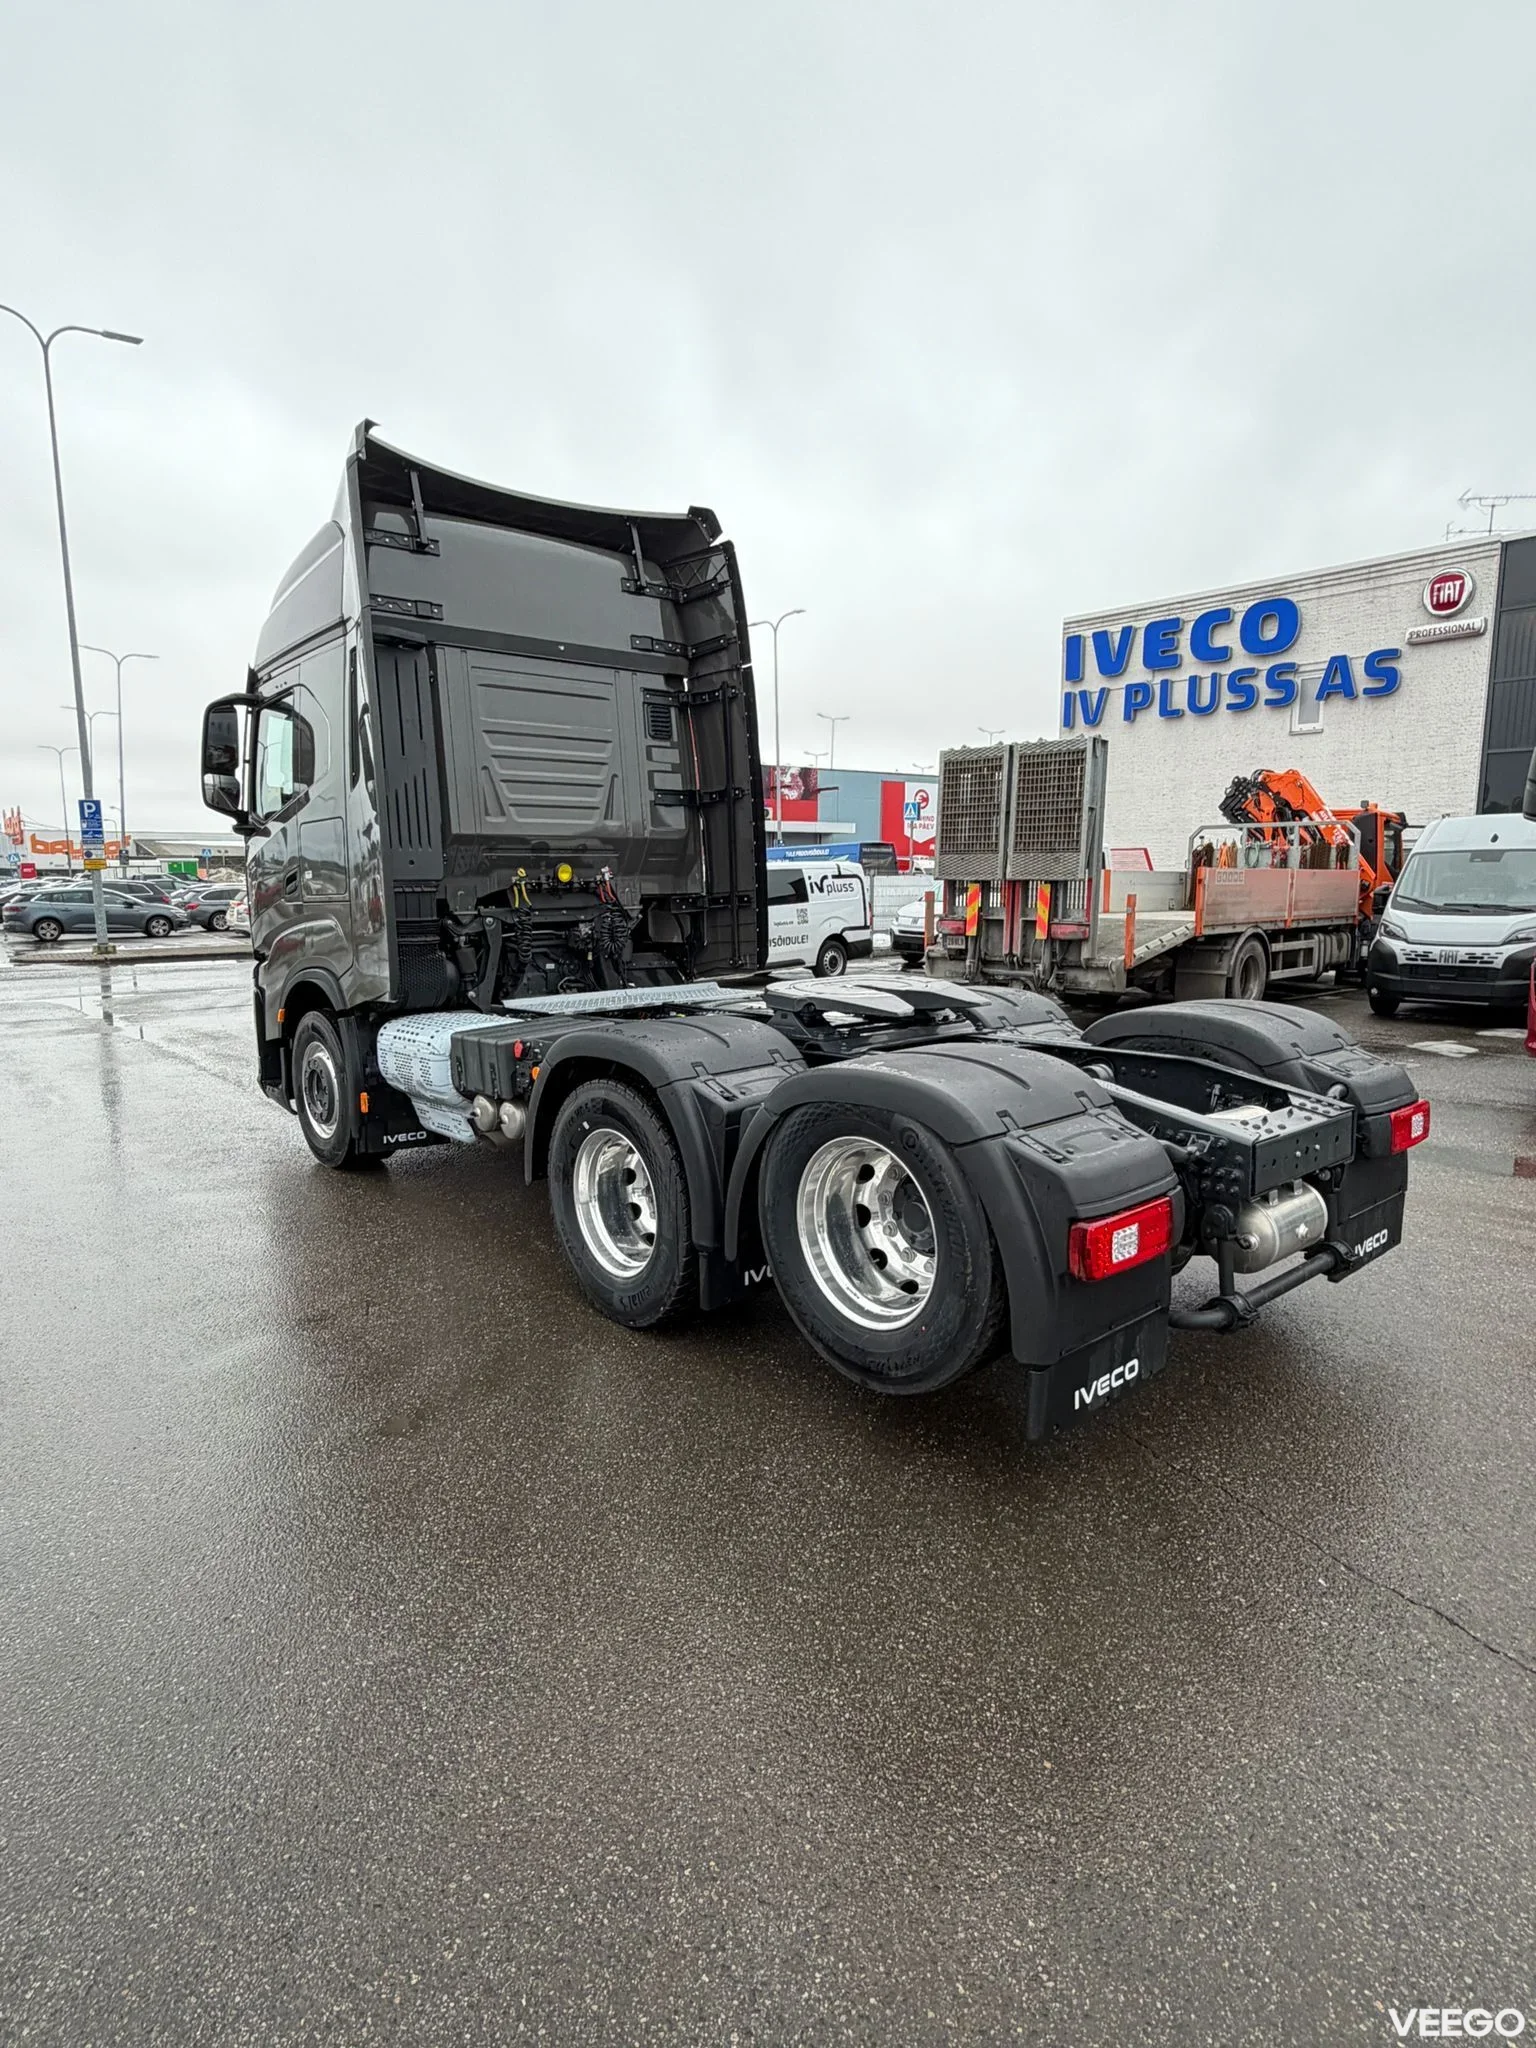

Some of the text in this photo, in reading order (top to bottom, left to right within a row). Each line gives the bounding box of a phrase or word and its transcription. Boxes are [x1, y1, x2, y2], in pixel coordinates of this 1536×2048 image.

[1432, 579, 1464, 605] FIAT
[1064, 597, 1301, 682] IVECO
[1408, 621, 1477, 639] PROFESSIONAL
[1062, 648, 1402, 729] IV PLUSS AS
[83, 802, 96, 818] P
[1438, 949, 1460, 964] FIAT
[383, 1131, 427, 1144] IVECO
[1354, 1228, 1388, 1257] IVECO
[1073, 1358, 1140, 1411] IVECO
